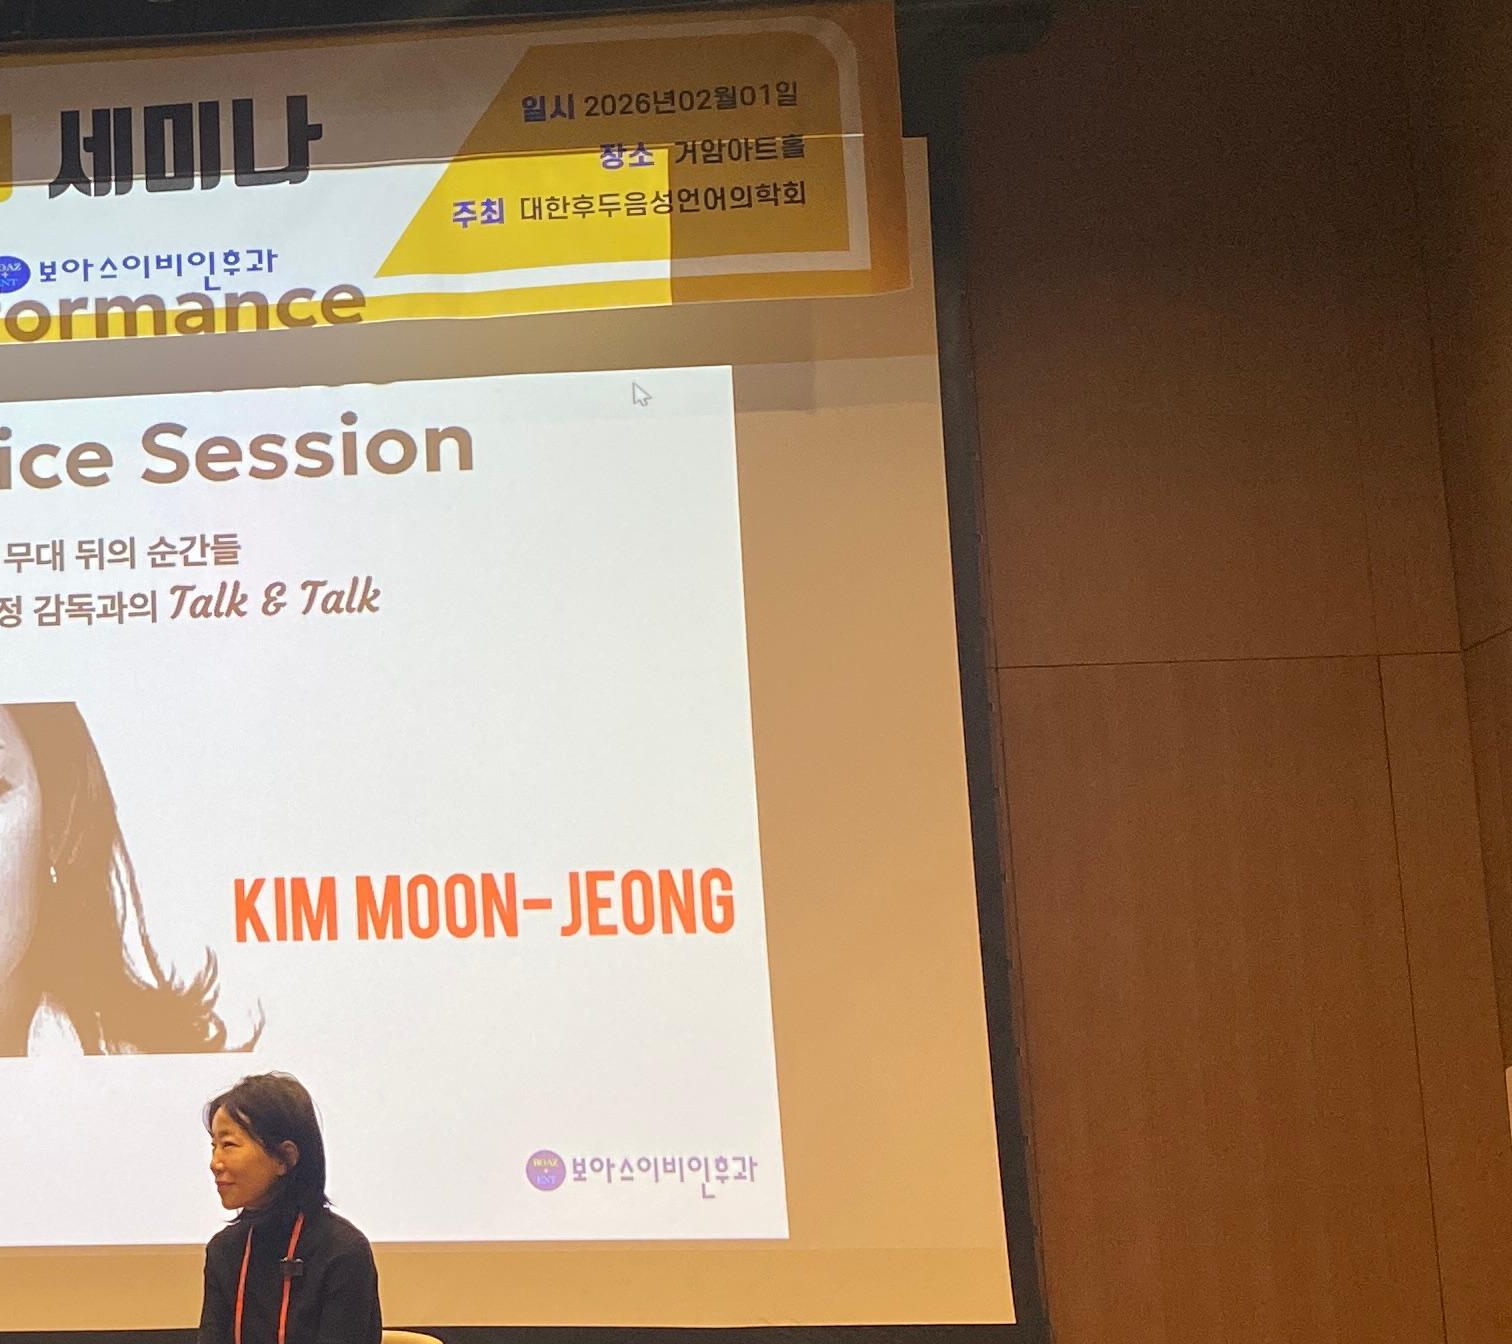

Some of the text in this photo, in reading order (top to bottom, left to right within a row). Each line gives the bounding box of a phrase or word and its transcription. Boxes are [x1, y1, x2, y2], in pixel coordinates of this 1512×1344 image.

[521, 81, 799, 123] 일시 2026년02월01일
[49, 95, 323, 199] 세미나
[600, 134, 806, 170] 장소 거암아트홀
[452, 181, 807, 229] 주최 대한후두음성언어의학회
[39, 249, 279, 291] 보아스이비인후과
[141, 411, 474, 485] Session
[4, 539, 65, 573] 무대
[75, 536, 137, 570] 뒤의
[146, 532, 241, 568] 순간들
[33, 590, 158, 627] 감독과의
[169, 580, 248, 620] Talk
[261, 581, 287, 617] &
[300, 575, 381, 616] Talk
[234, 867, 735, 943] KIM MOON-JEONG
[572, 1156, 758, 1199] 보아스이비인후과
